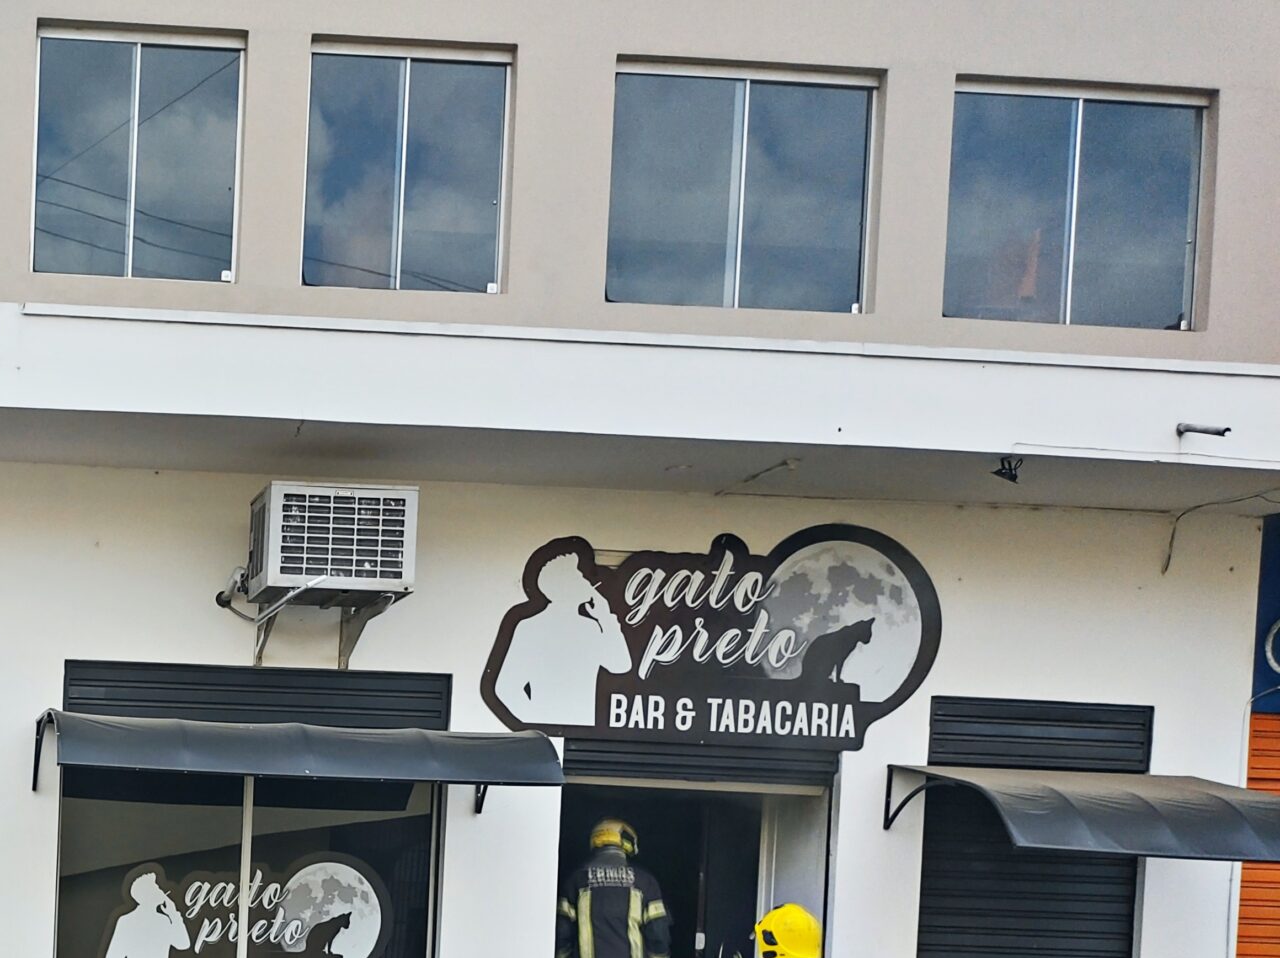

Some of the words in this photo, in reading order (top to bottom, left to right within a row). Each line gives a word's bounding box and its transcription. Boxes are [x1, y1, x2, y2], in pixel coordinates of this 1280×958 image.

[624, 549, 775, 627] gato
[638, 609, 807, 680] preto
[609, 694, 665, 730] BAR
[675, 696, 696, 731] &
[708, 697, 856, 738] TABACARIA
[184, 869, 288, 918] gato
[194, 906, 310, 954] preto
